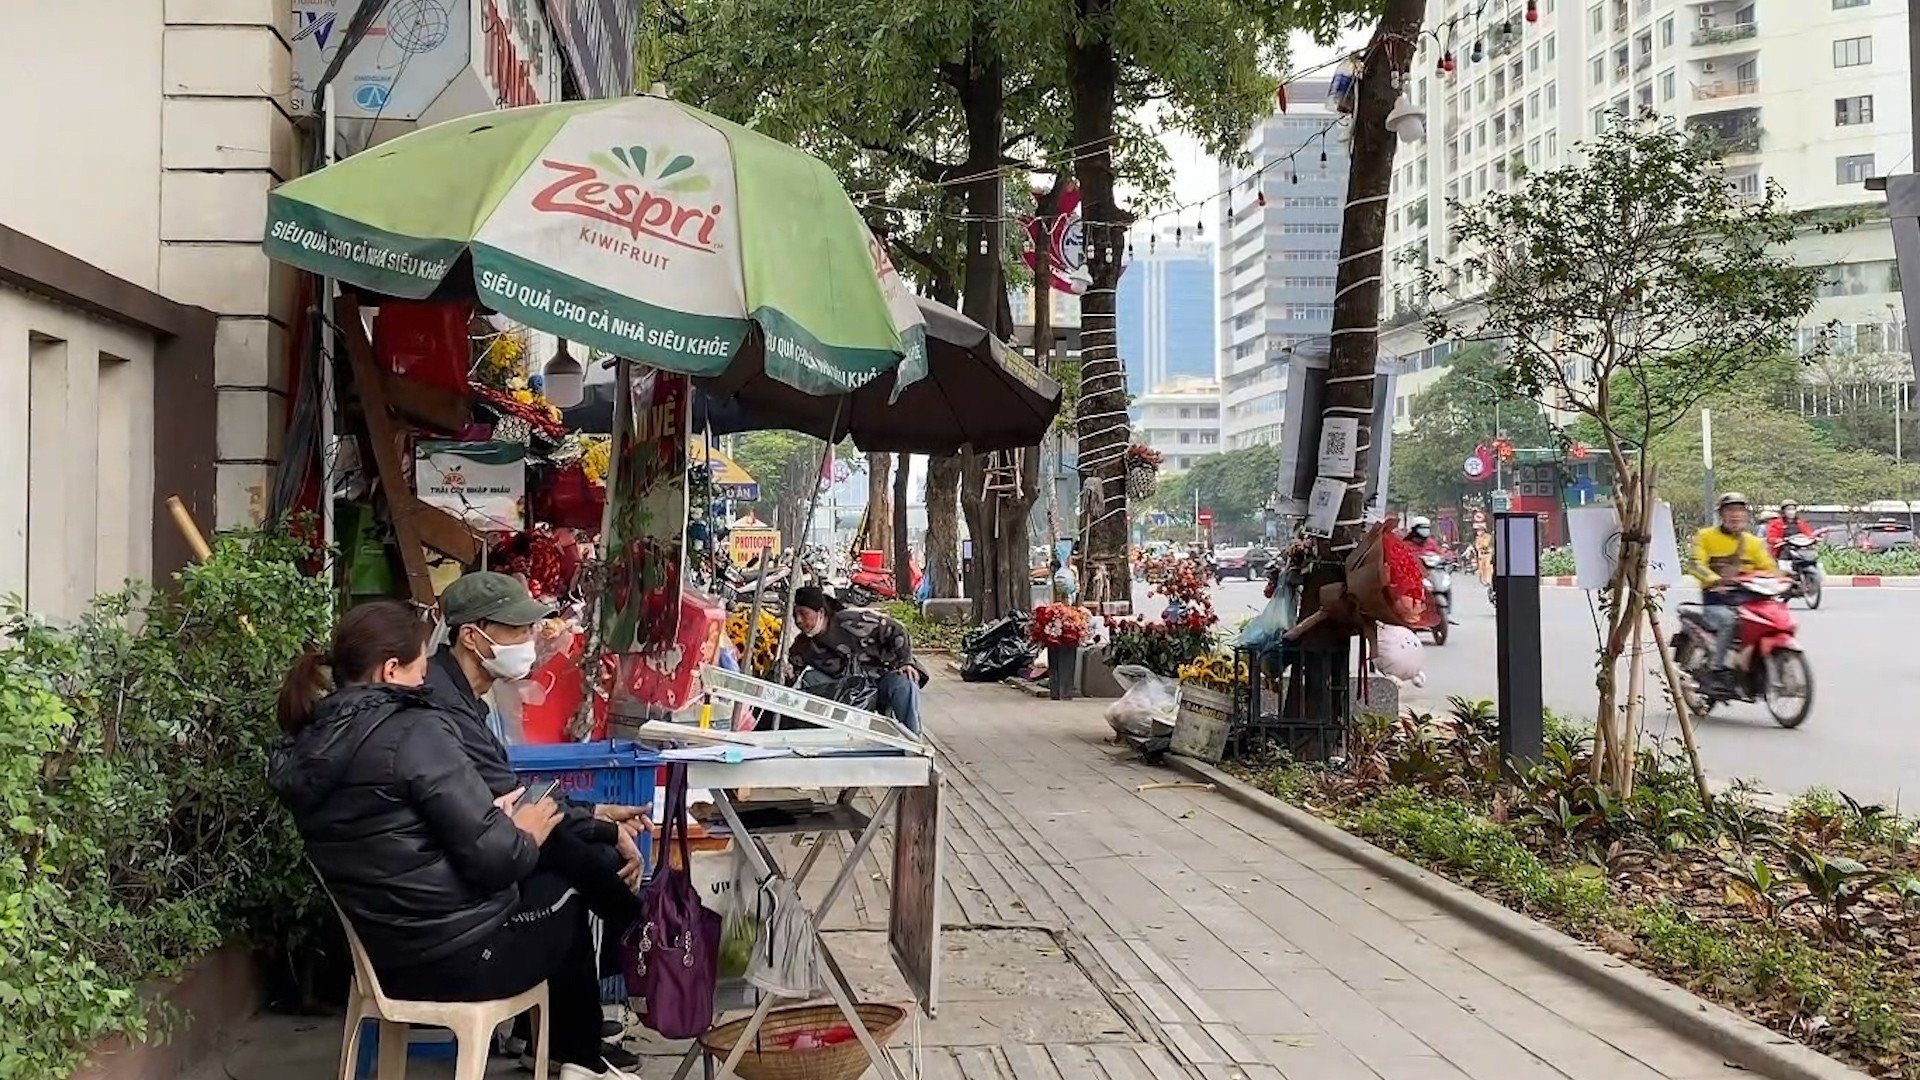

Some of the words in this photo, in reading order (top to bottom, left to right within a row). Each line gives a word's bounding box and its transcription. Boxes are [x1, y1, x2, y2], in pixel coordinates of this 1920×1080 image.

[532, 159, 721, 254] Zespri
[271, 221, 303, 244] SIÊU
[328, 238, 351, 259] CHO
[387, 252, 418, 275] SIÊU
[579, 227, 671, 271] KIWIFRUIT
[481, 270, 518, 299] SIÊU
[518, 288, 551, 313] QUẢ
[553, 299, 586, 323] CHO
[588, 309, 610, 332] CẢ
[611, 317, 645, 342] NHÀ
[647, 329, 686, 352] SIÊU
[686, 335, 730, 358] KHỎE
[734, 536, 776, 549] PHOTOCOPY
